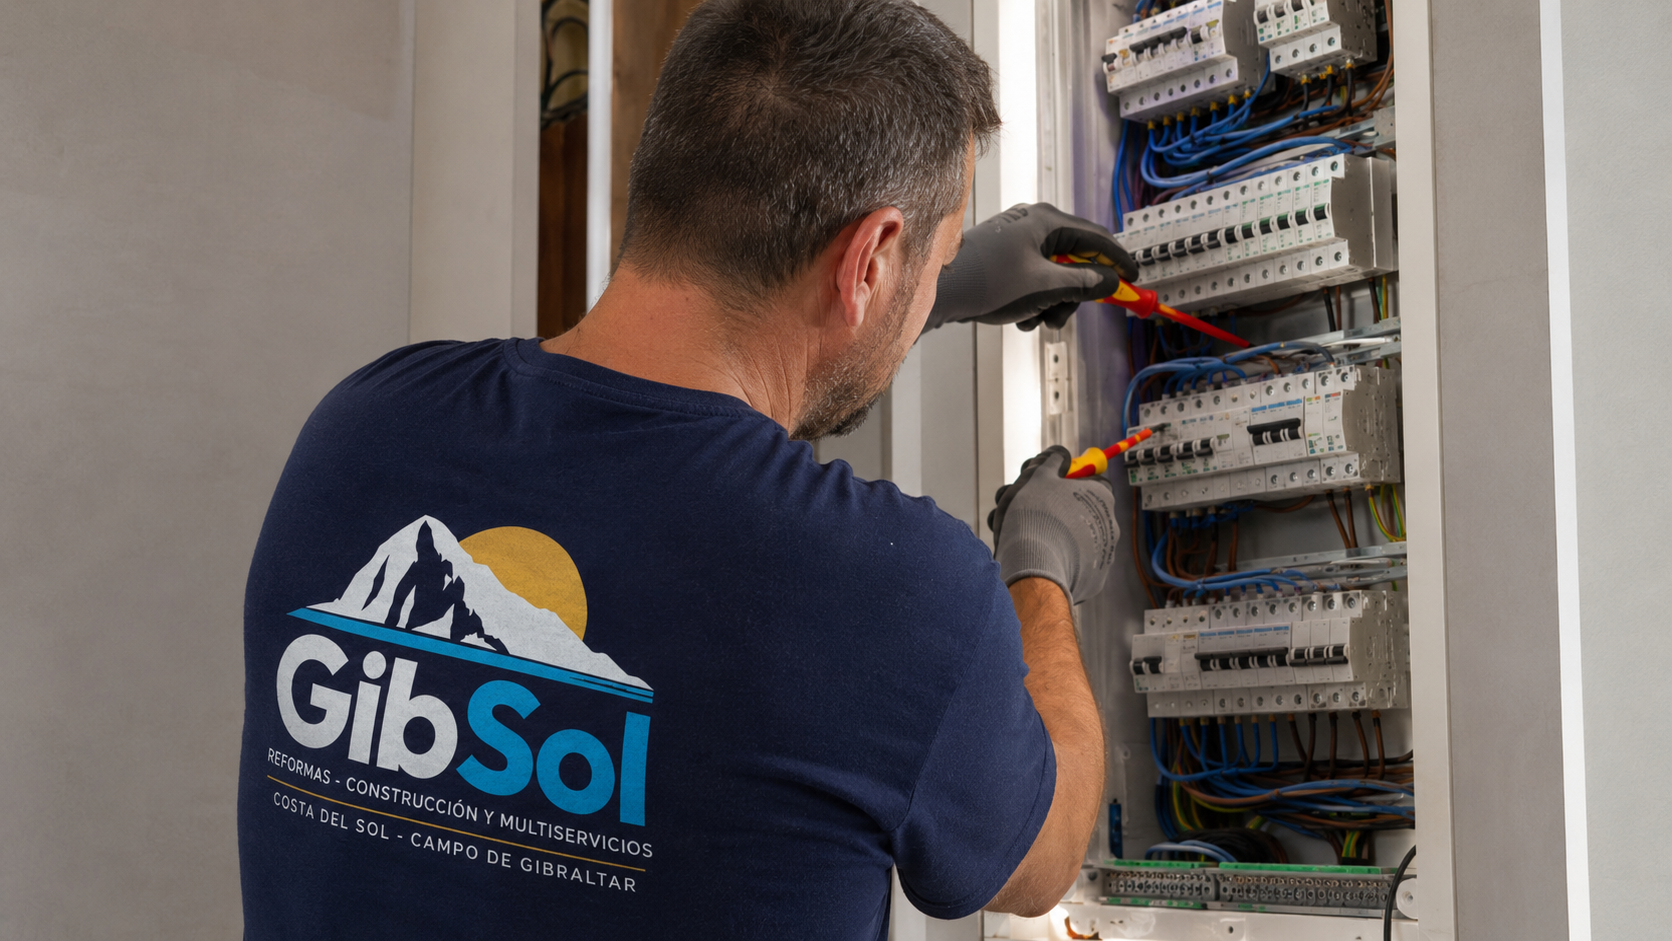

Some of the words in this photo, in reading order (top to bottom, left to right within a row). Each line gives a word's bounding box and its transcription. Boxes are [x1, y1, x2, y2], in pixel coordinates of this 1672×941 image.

[276, 633, 651, 827] GibSol
[267, 747, 331, 785] REFORMAS
[346, 776, 478, 823] CONSTRUCCIÓN
[484, 809, 495, 825] Y
[500, 813, 653, 858] MULTISERVICIOS
[273, 791, 315, 819] COSTA
[320, 808, 348, 830] DEL
[355, 818, 390, 840] SOL
[410, 832, 478, 860] CAMPO
[487, 849, 512, 868] DE
[520, 857, 636, 893] GIBRALTAR
